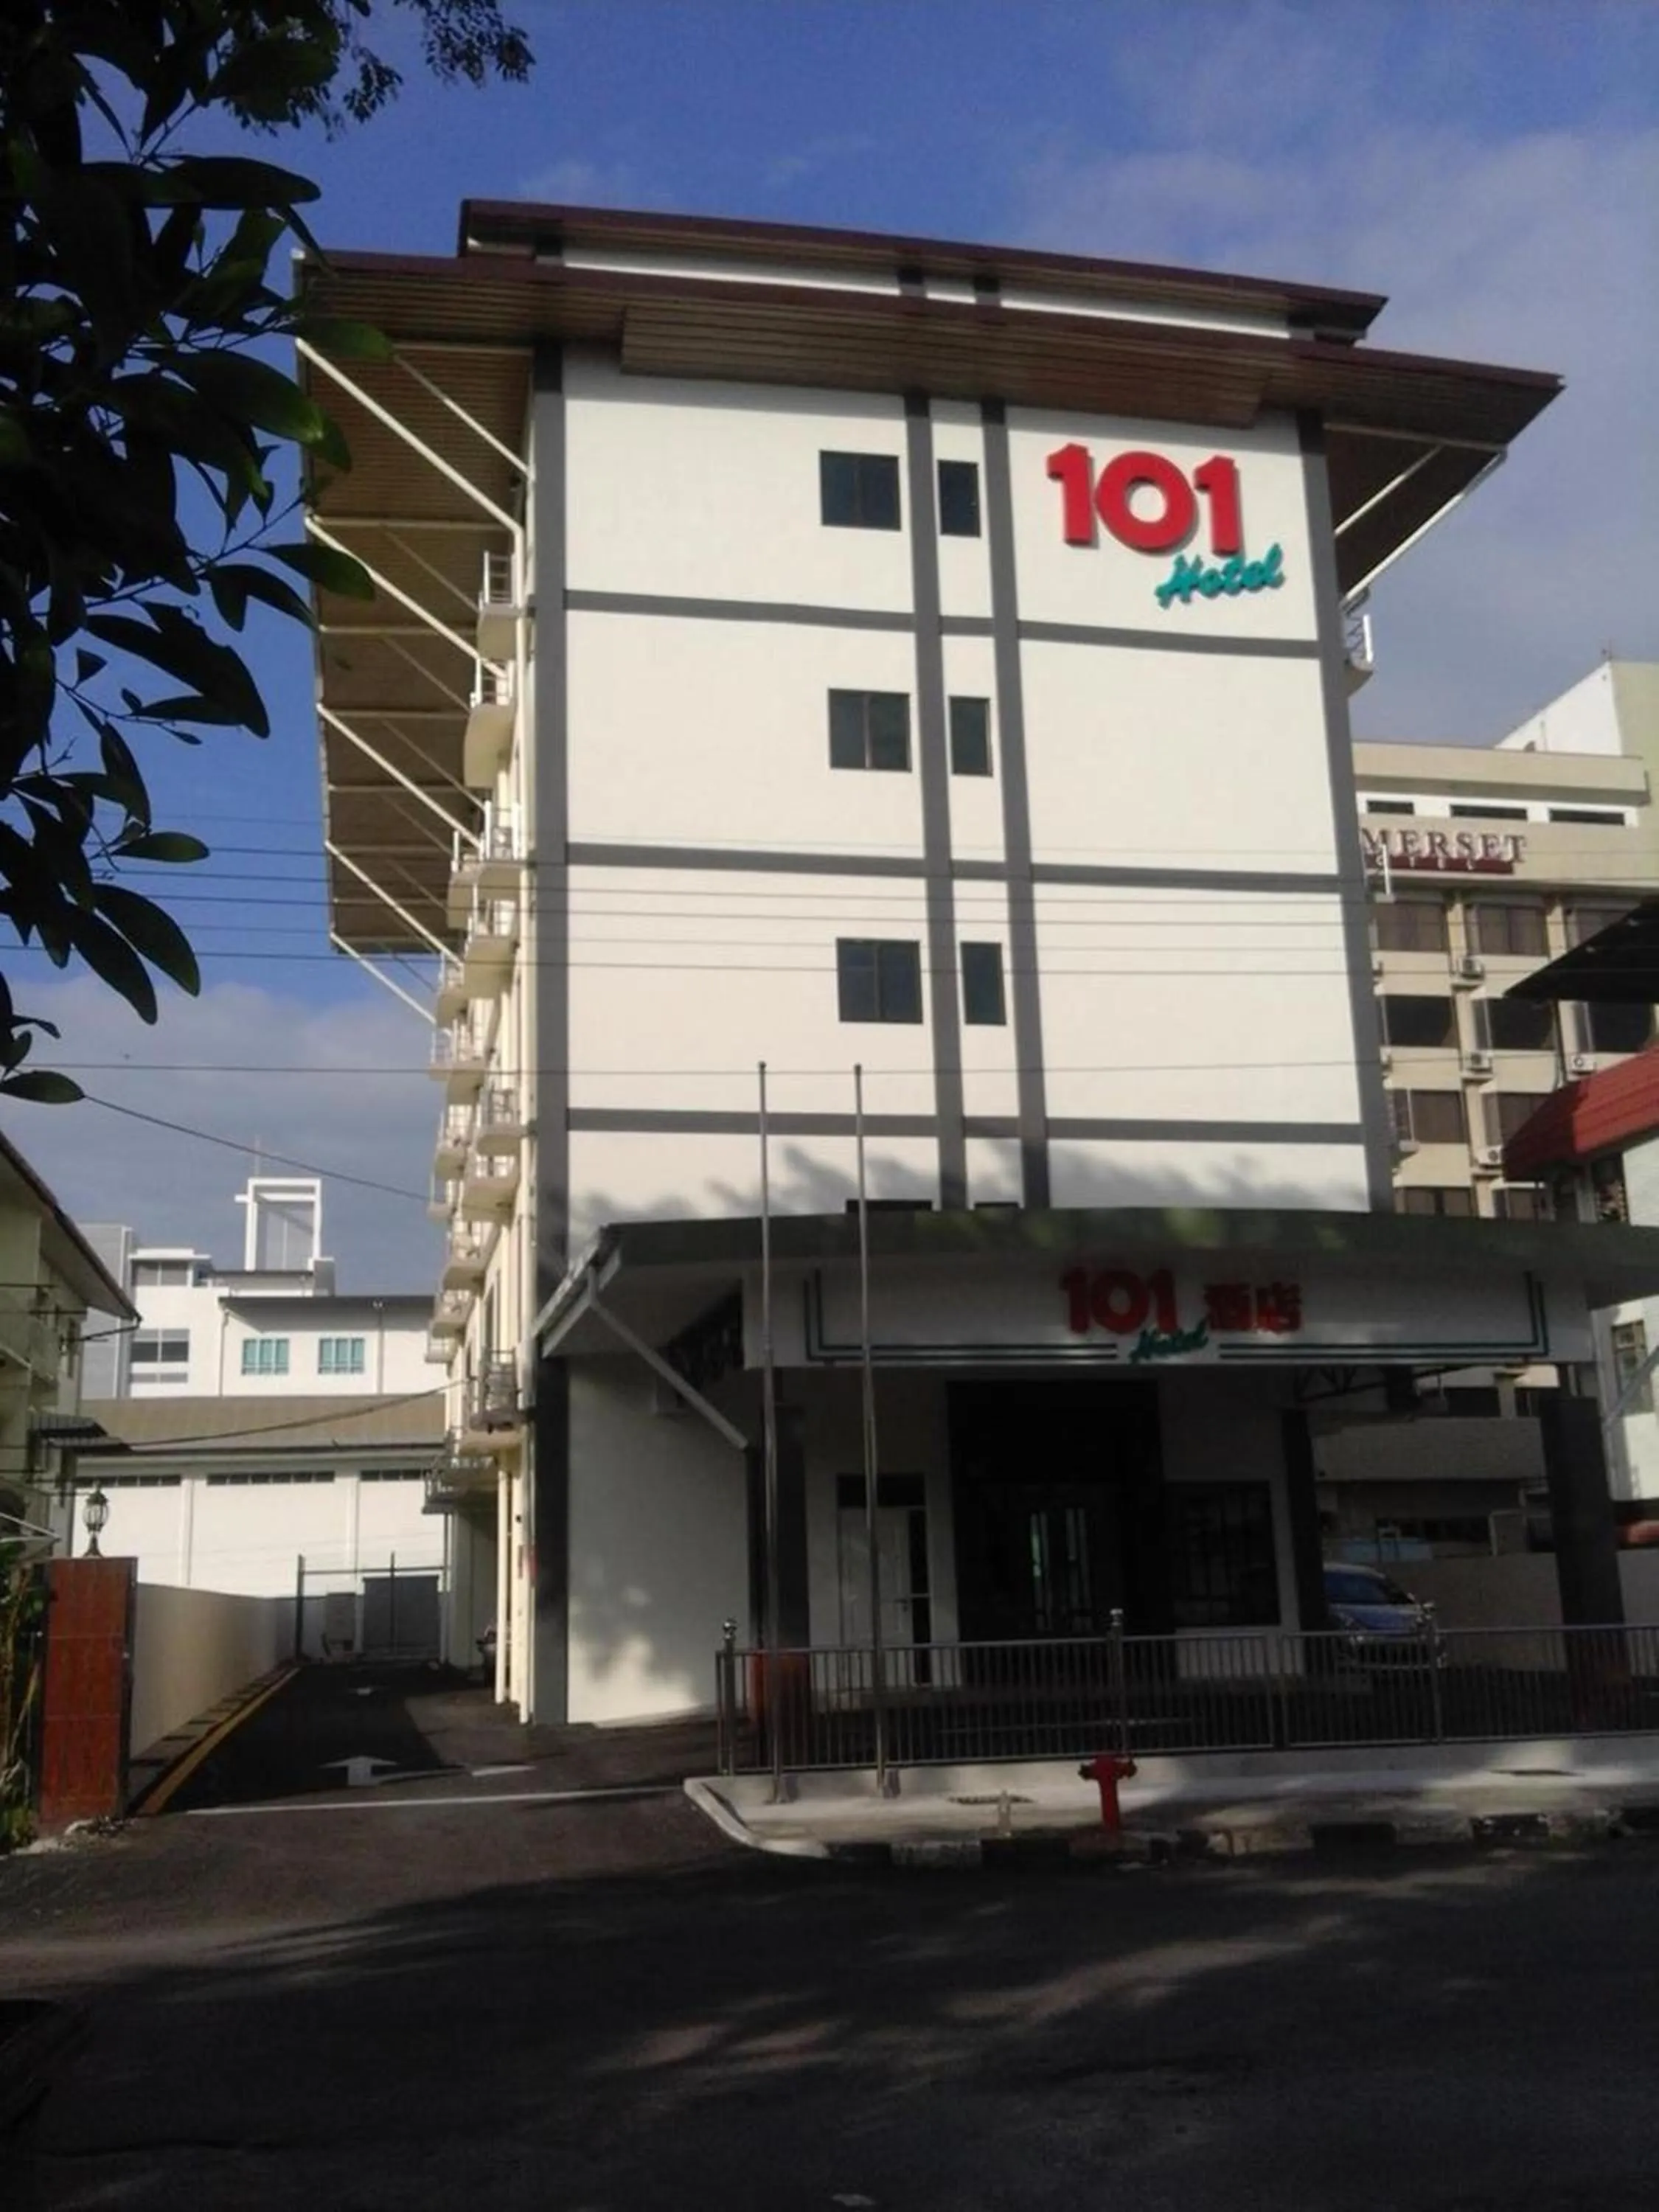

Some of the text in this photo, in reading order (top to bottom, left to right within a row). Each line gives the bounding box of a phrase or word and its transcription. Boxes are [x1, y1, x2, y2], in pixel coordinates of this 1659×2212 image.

[1046, 442, 1242, 557] 101
[1154, 542, 1286, 610] Hotel
[1060, 1266, 1303, 1335] 101 酒店
